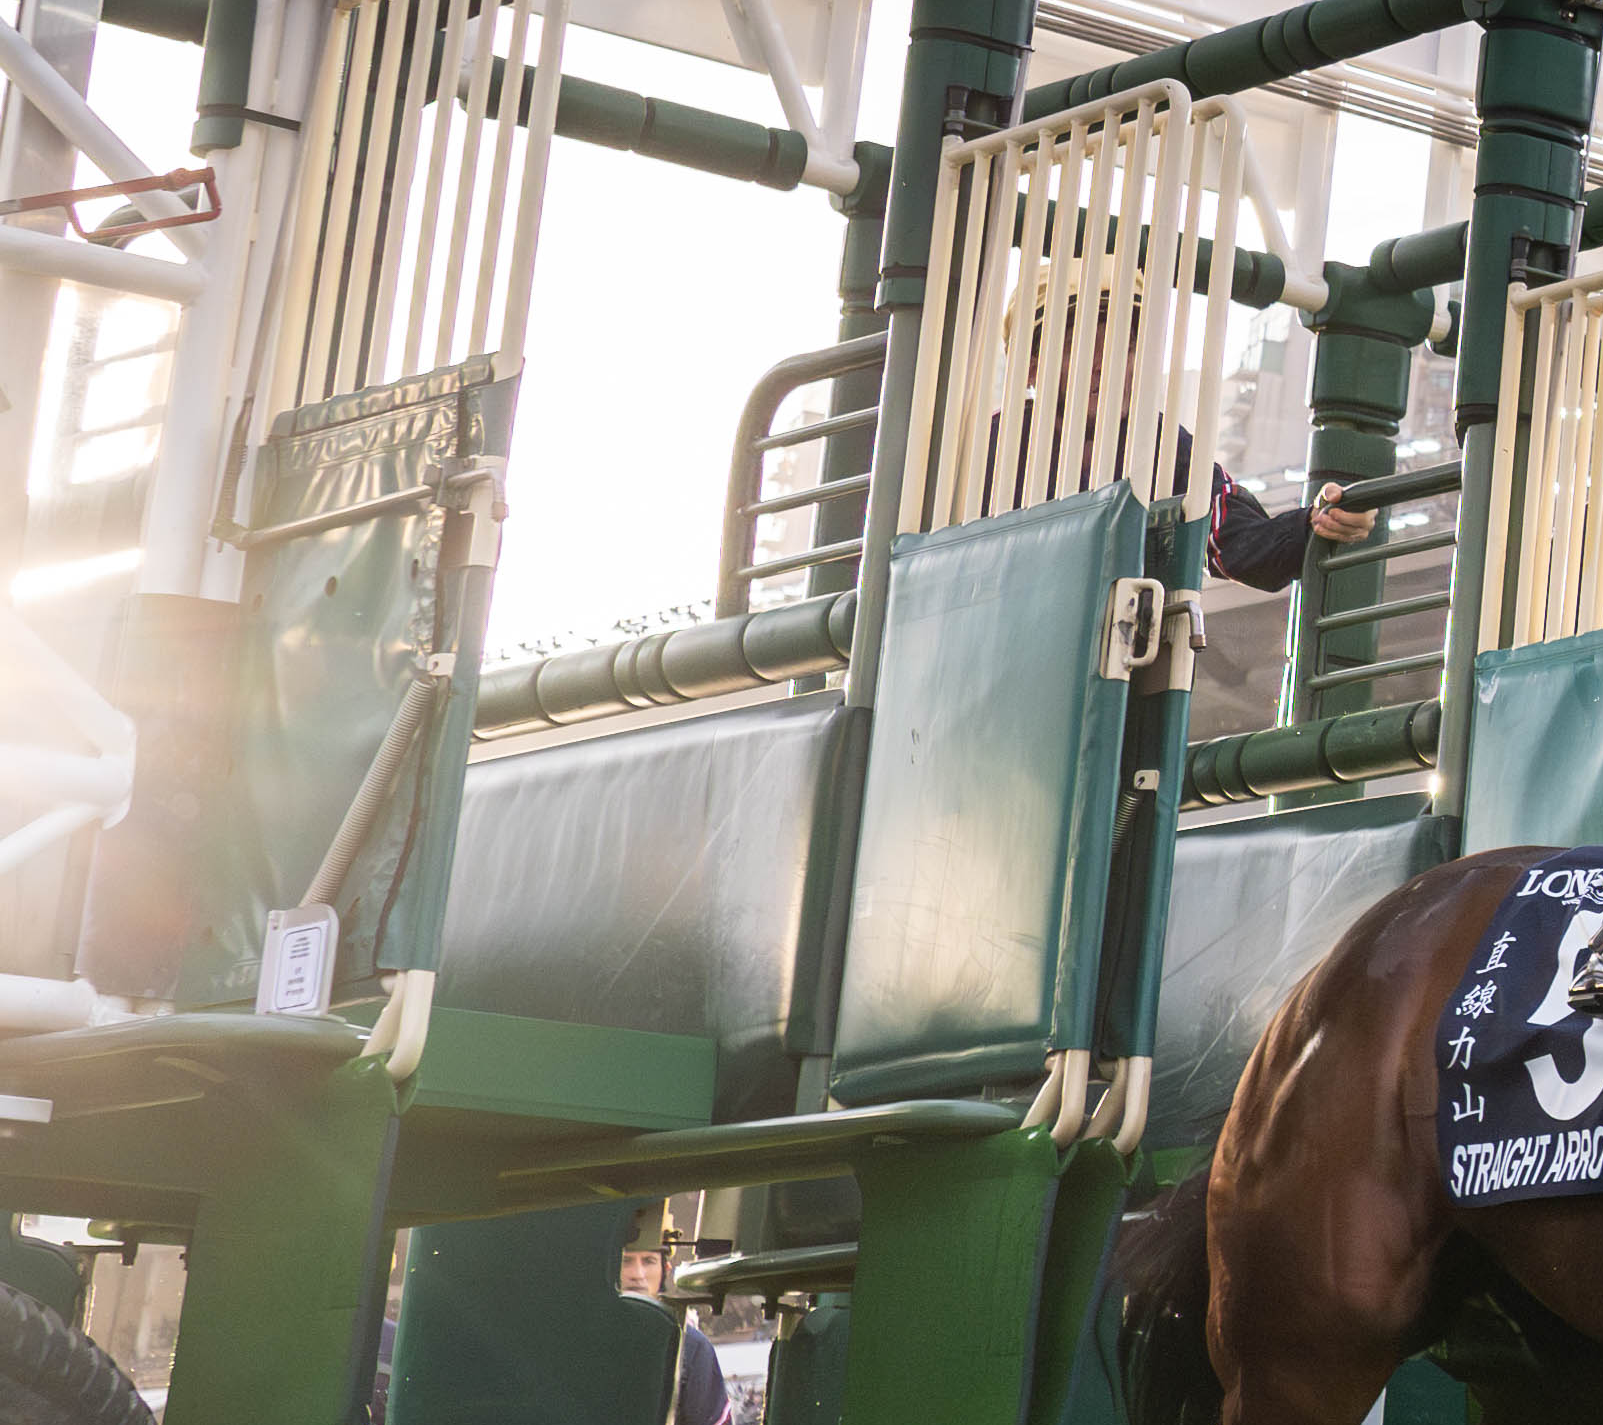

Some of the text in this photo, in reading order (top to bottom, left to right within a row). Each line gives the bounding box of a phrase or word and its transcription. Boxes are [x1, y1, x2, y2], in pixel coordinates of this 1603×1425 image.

[1448, 931, 1516, 1123] 直線力山
[1451, 1133, 1551, 1198] STRAIGHT
